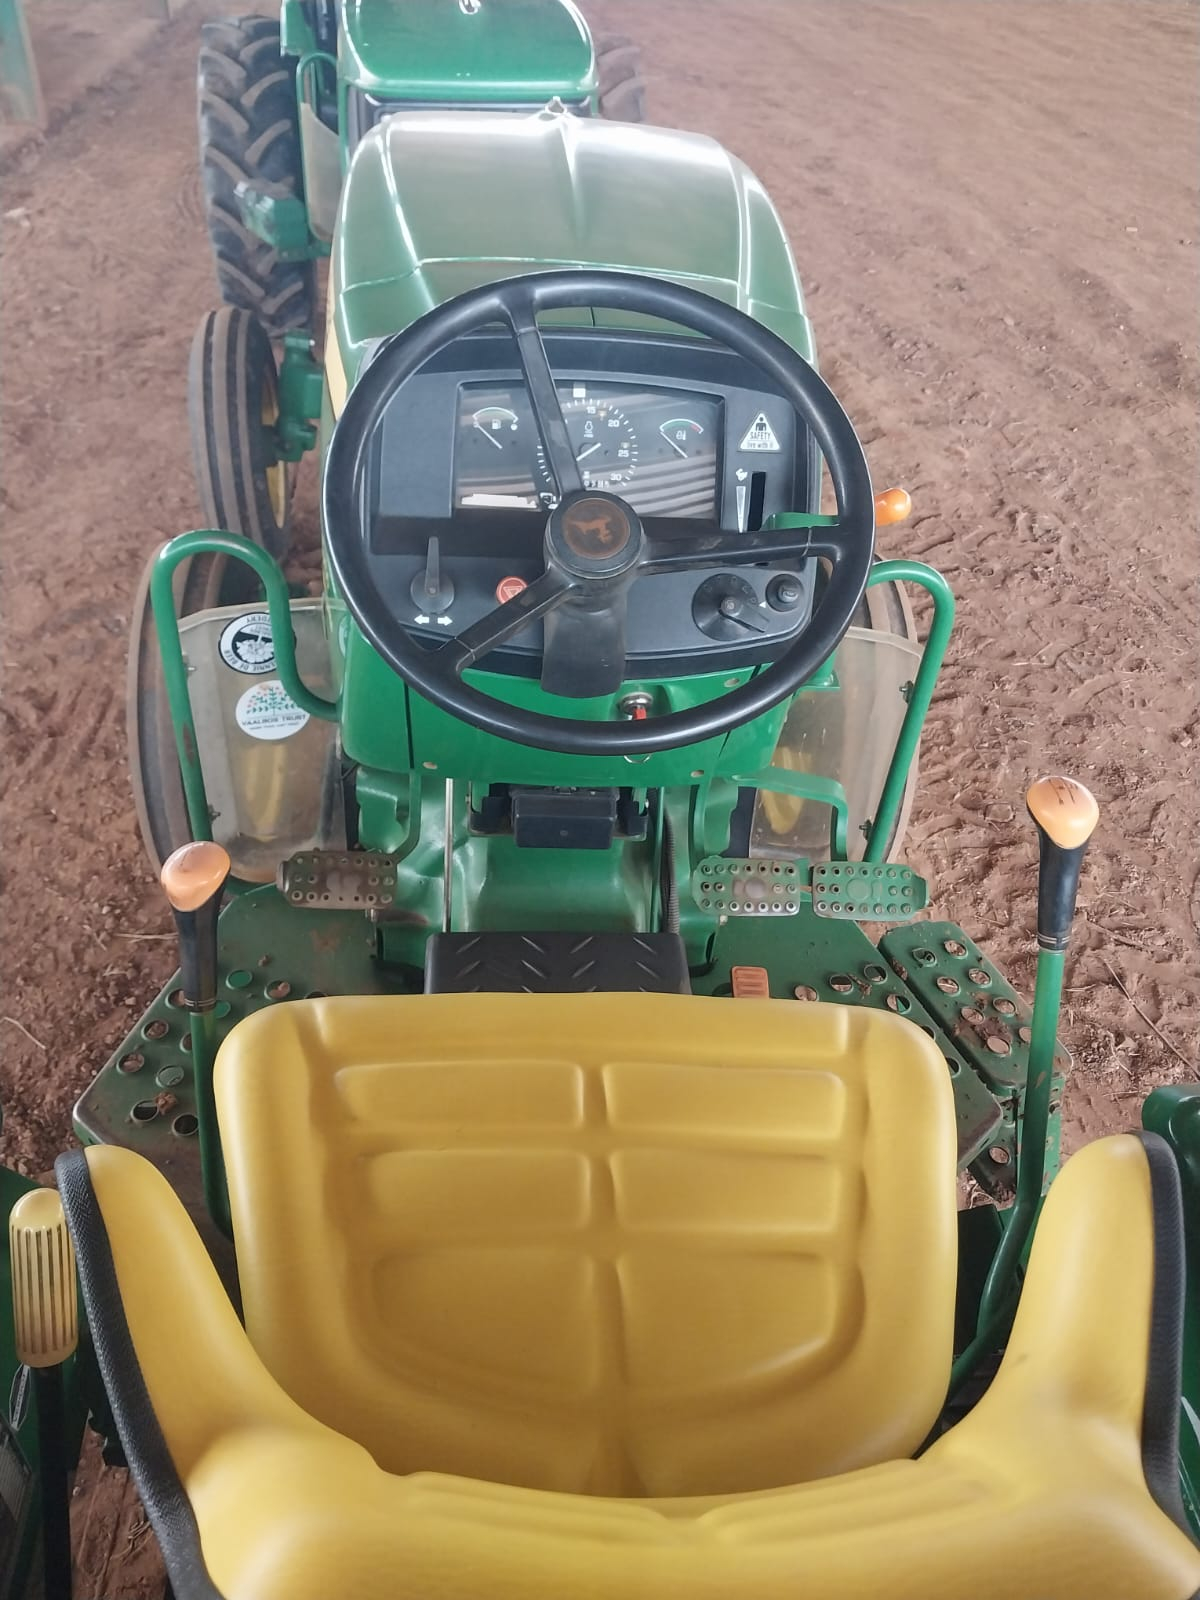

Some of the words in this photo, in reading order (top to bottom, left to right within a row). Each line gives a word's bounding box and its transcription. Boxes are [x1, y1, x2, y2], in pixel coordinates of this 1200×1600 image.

[586, 406, 596, 415] 15
[607, 419, 620, 428] 20
[749, 431, 771, 440] SAFETY
[617, 449, 630, 458] 25
